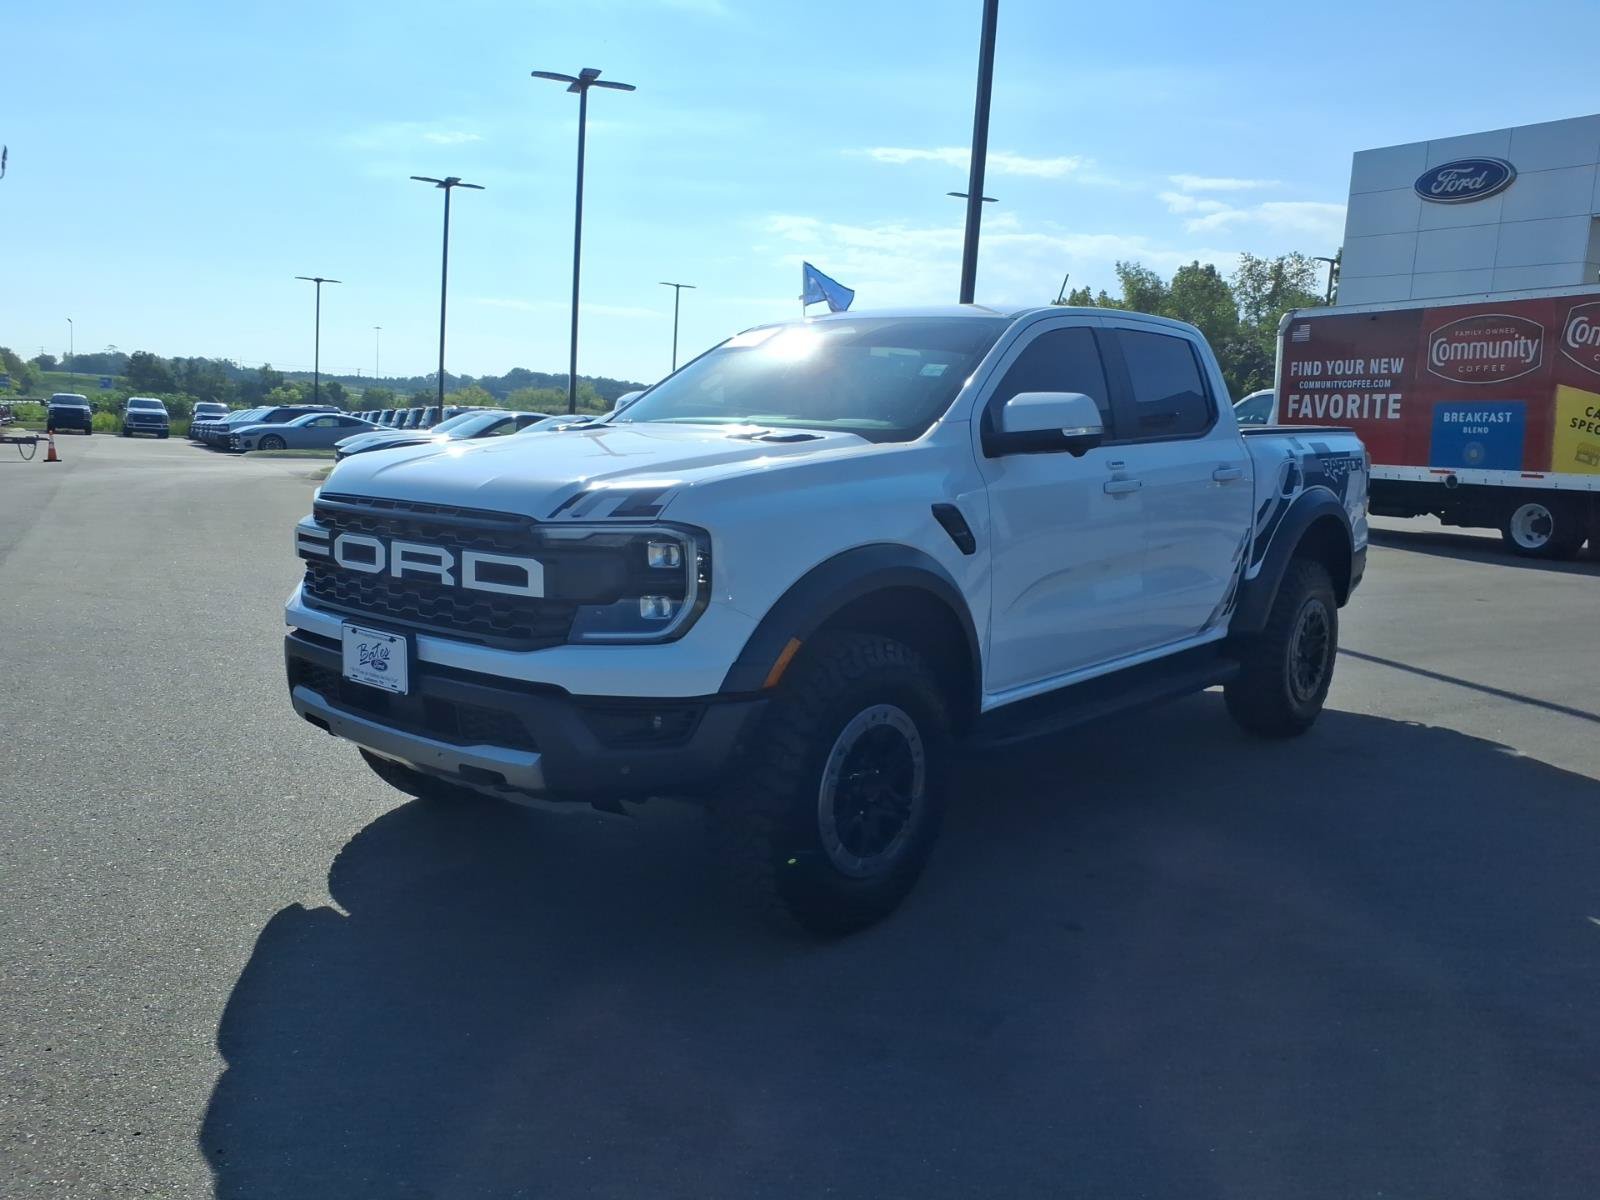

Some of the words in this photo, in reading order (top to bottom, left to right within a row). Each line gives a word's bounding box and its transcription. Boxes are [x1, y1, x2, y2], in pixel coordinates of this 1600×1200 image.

[1431, 167, 1488, 194] Ford
[1485, 327, 1516, 335] OWNED
[1432, 333, 1539, 366] Community
[1290, 361, 1322, 376] FIND
[1326, 359, 1365, 375] YOUR
[1369, 357, 1404, 374] NEW
[1458, 364, 1506, 373] COFFEE
[1299, 379, 1391, 389] COMMUNITYCOFFEE.COM
[1287, 393, 1402, 419] FAVORITE
[1443, 411, 1512, 423] BREAKFAST
[1463, 426, 1489, 434] BLEND
[1319, 456, 1365, 483] RAPTOR
[295, 526, 544, 598] FORD
